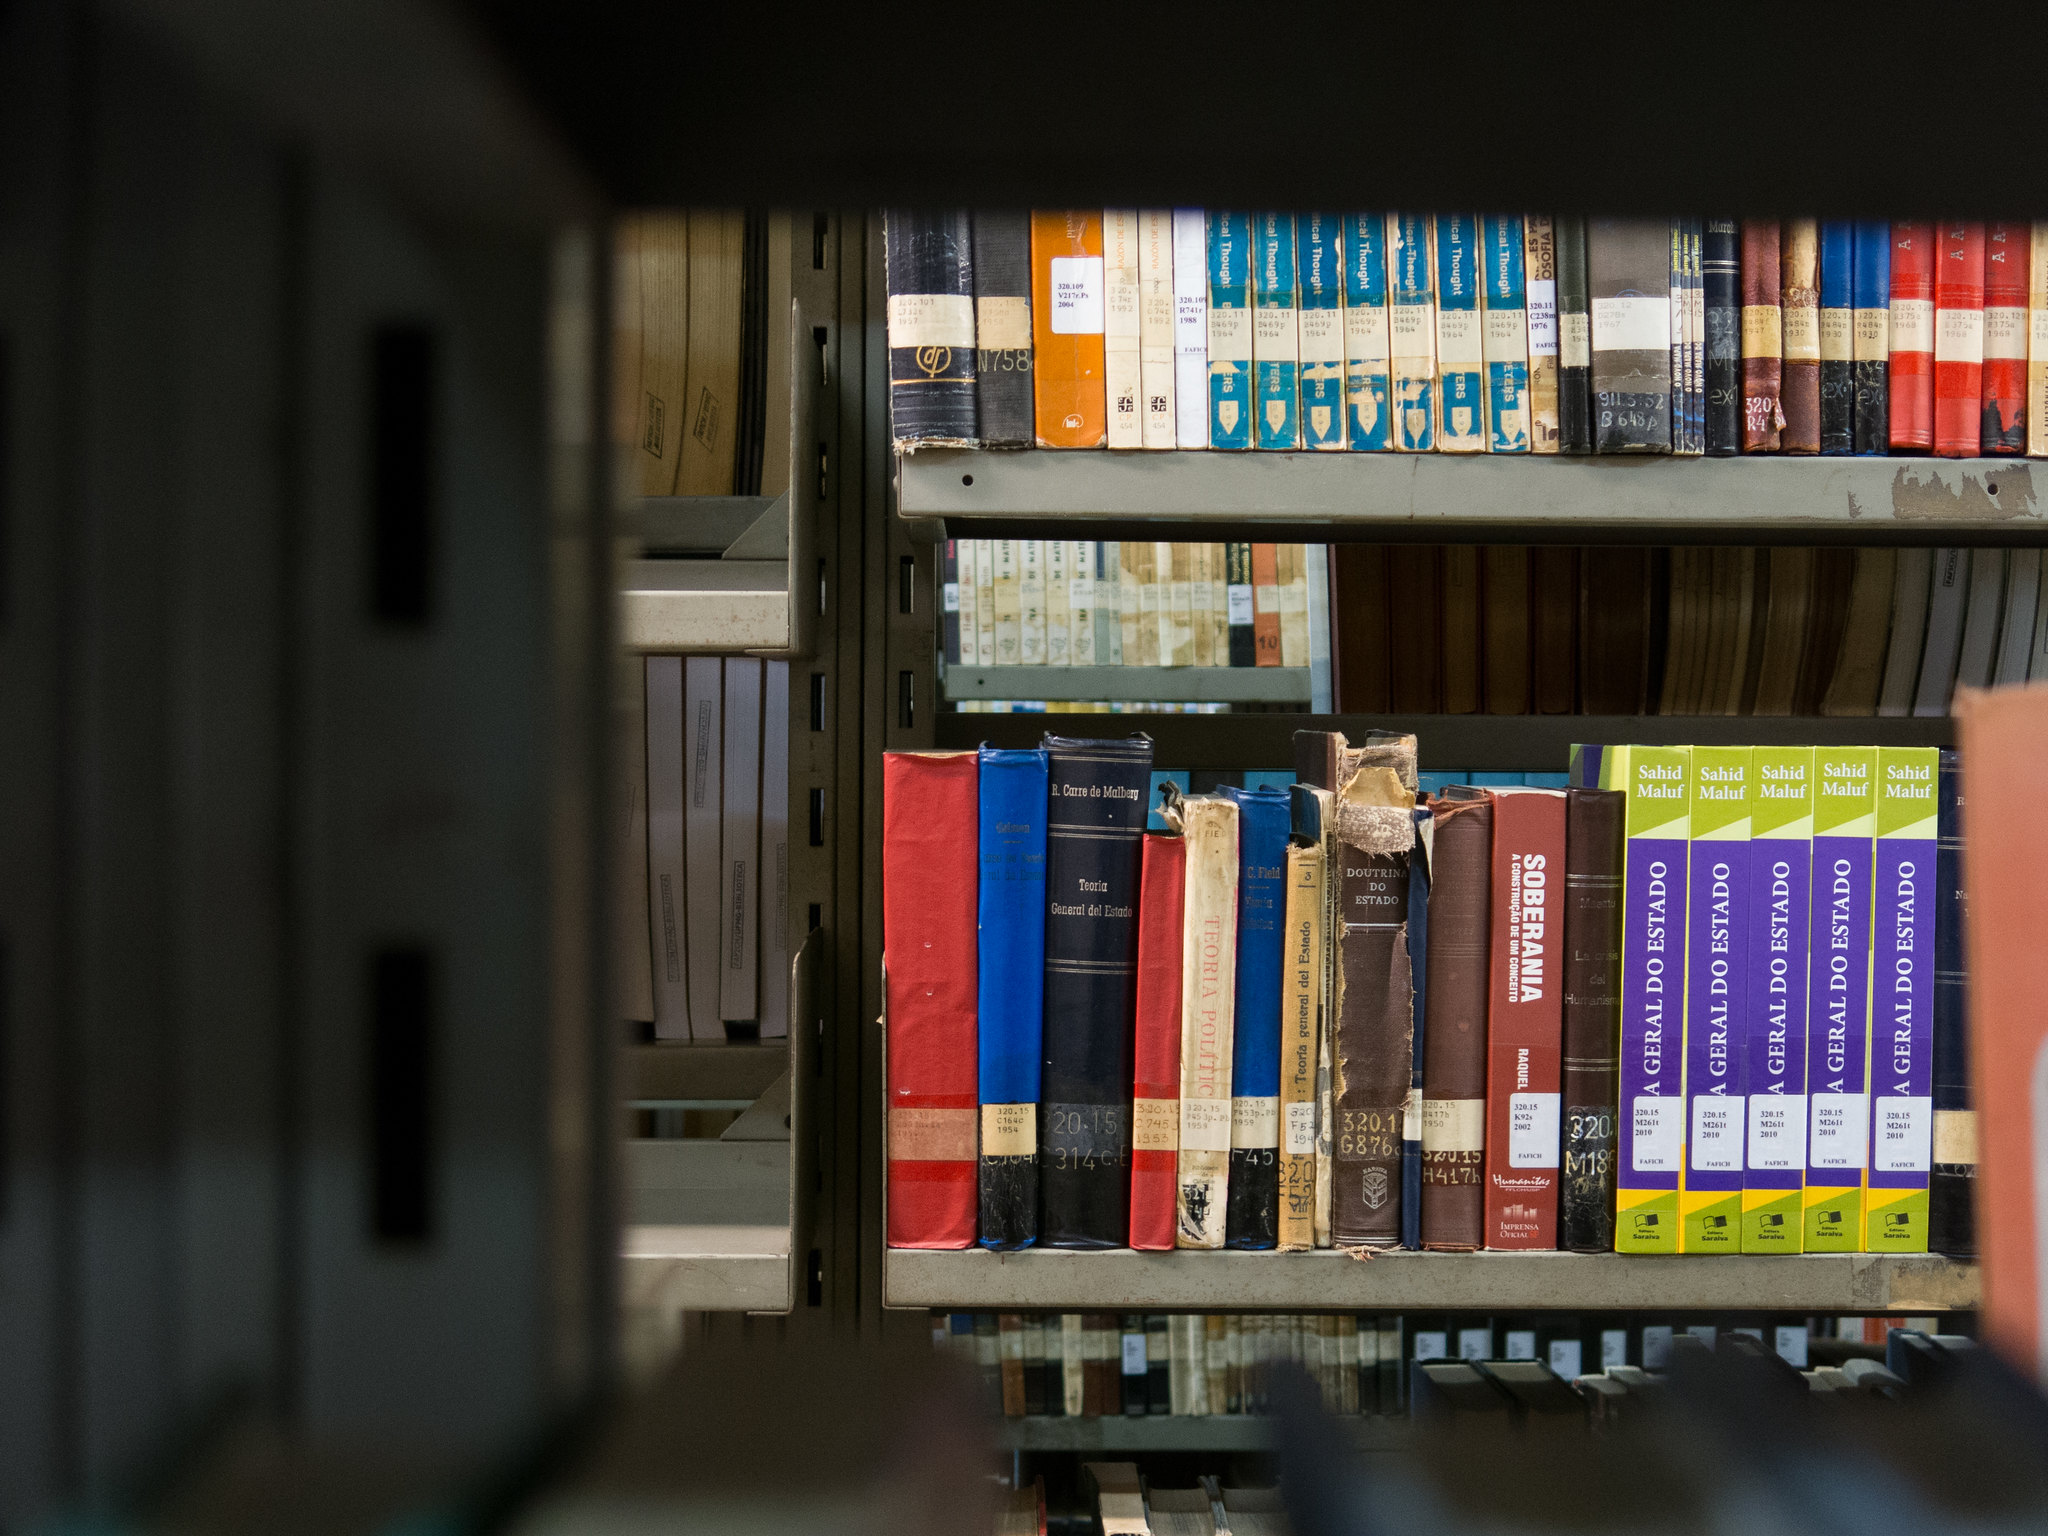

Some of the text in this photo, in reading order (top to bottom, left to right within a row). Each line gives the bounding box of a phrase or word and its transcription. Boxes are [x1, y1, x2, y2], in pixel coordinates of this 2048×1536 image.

[1541, 232, 1553, 281] OSOFIA
[1992, 251, 2005, 263] A
[1220, 241, 1232, 289] Thought
[1266, 241, 1279, 289] Thought
[1310, 247, 1323, 295] Thought
[1357, 241, 1372, 290] Thought
[1450, 248, 1463, 296] Thought
[1405, 250, 1417, 297] Thought
[1498, 251, 1512, 299] Thought
[1211, 311, 1244, 319] 320.11
[1258, 311, 1290, 319] 320.11
[1304, 311, 1337, 319] 320.11
[1350, 308, 1382, 316] 320.11
[1394, 306, 1426, 314] 320.11
[1986, 312, 2026, 320] 320.129
[1531, 322, 1548, 330] 1976
[1858, 330, 1878, 338] 1930
[1673, 363, 1682, 381] NOVO
[1683, 350, 1692, 386] NOVO MAPA
[1694, 351, 1703, 387] NOVO MAPA
[1639, 765, 1682, 780] Sahid
[1701, 767, 1744, 782] Sahid
[1762, 765, 1805, 780] Sahid
[1824, 763, 1867, 778] Sahid
[1887, 765, 1930, 780] Sahid
[1052, 783, 1139, 800] R. Carre de Malberg
[1637, 783, 1685, 799] Maluf
[1699, 785, 1747, 801] Maluf
[1760, 783, 1808, 799] Maluf
[1822, 781, 1870, 797] Maluf
[1885, 783, 1933, 799] Maluf
[1258, 867, 1281, 879] Field
[1346, 868, 1408, 878] DOUTRINA
[1369, 882, 1386, 891] DO
[1509, 862, 1520, 920] CONSTRUÇÃO
[1355, 896, 1399, 905] ESTADO
[1051, 903, 1132, 918] General del Estado
[1510, 924, 1519, 938] DE
[1521, 853, 1546, 1003] SOBERANIA
[1509, 940, 1519, 955] UM
[1643, 861, 1667, 1075] GERAL DO ESTADO
[1709, 863, 1730, 1077] GERAL DO ESTADO
[1768, 861, 1790, 1075] GERAL DO ESTADO
[1827, 859, 1851, 1073] GERAL DO ESTADO
[1893, 861, 1915, 1074] GERAL DO ESTADO
[1508, 957, 1519, 1003] CONCEITO
[1199, 915, 1220, 1097] TEORIA POLÍTIC
[1295, 921, 1311, 1084] Teoría general del Estado
[1517, 1047, 1529, 1090] RAQUEL
[997, 1107, 1030, 1116] 320.15
[1344, 1113, 1396, 1133] 320.1
[1423, 1120, 1444, 1128] 1950
[1423, 1168, 1482, 1185] H417h
[1493, 1174, 1550, 1186] Humanitas
